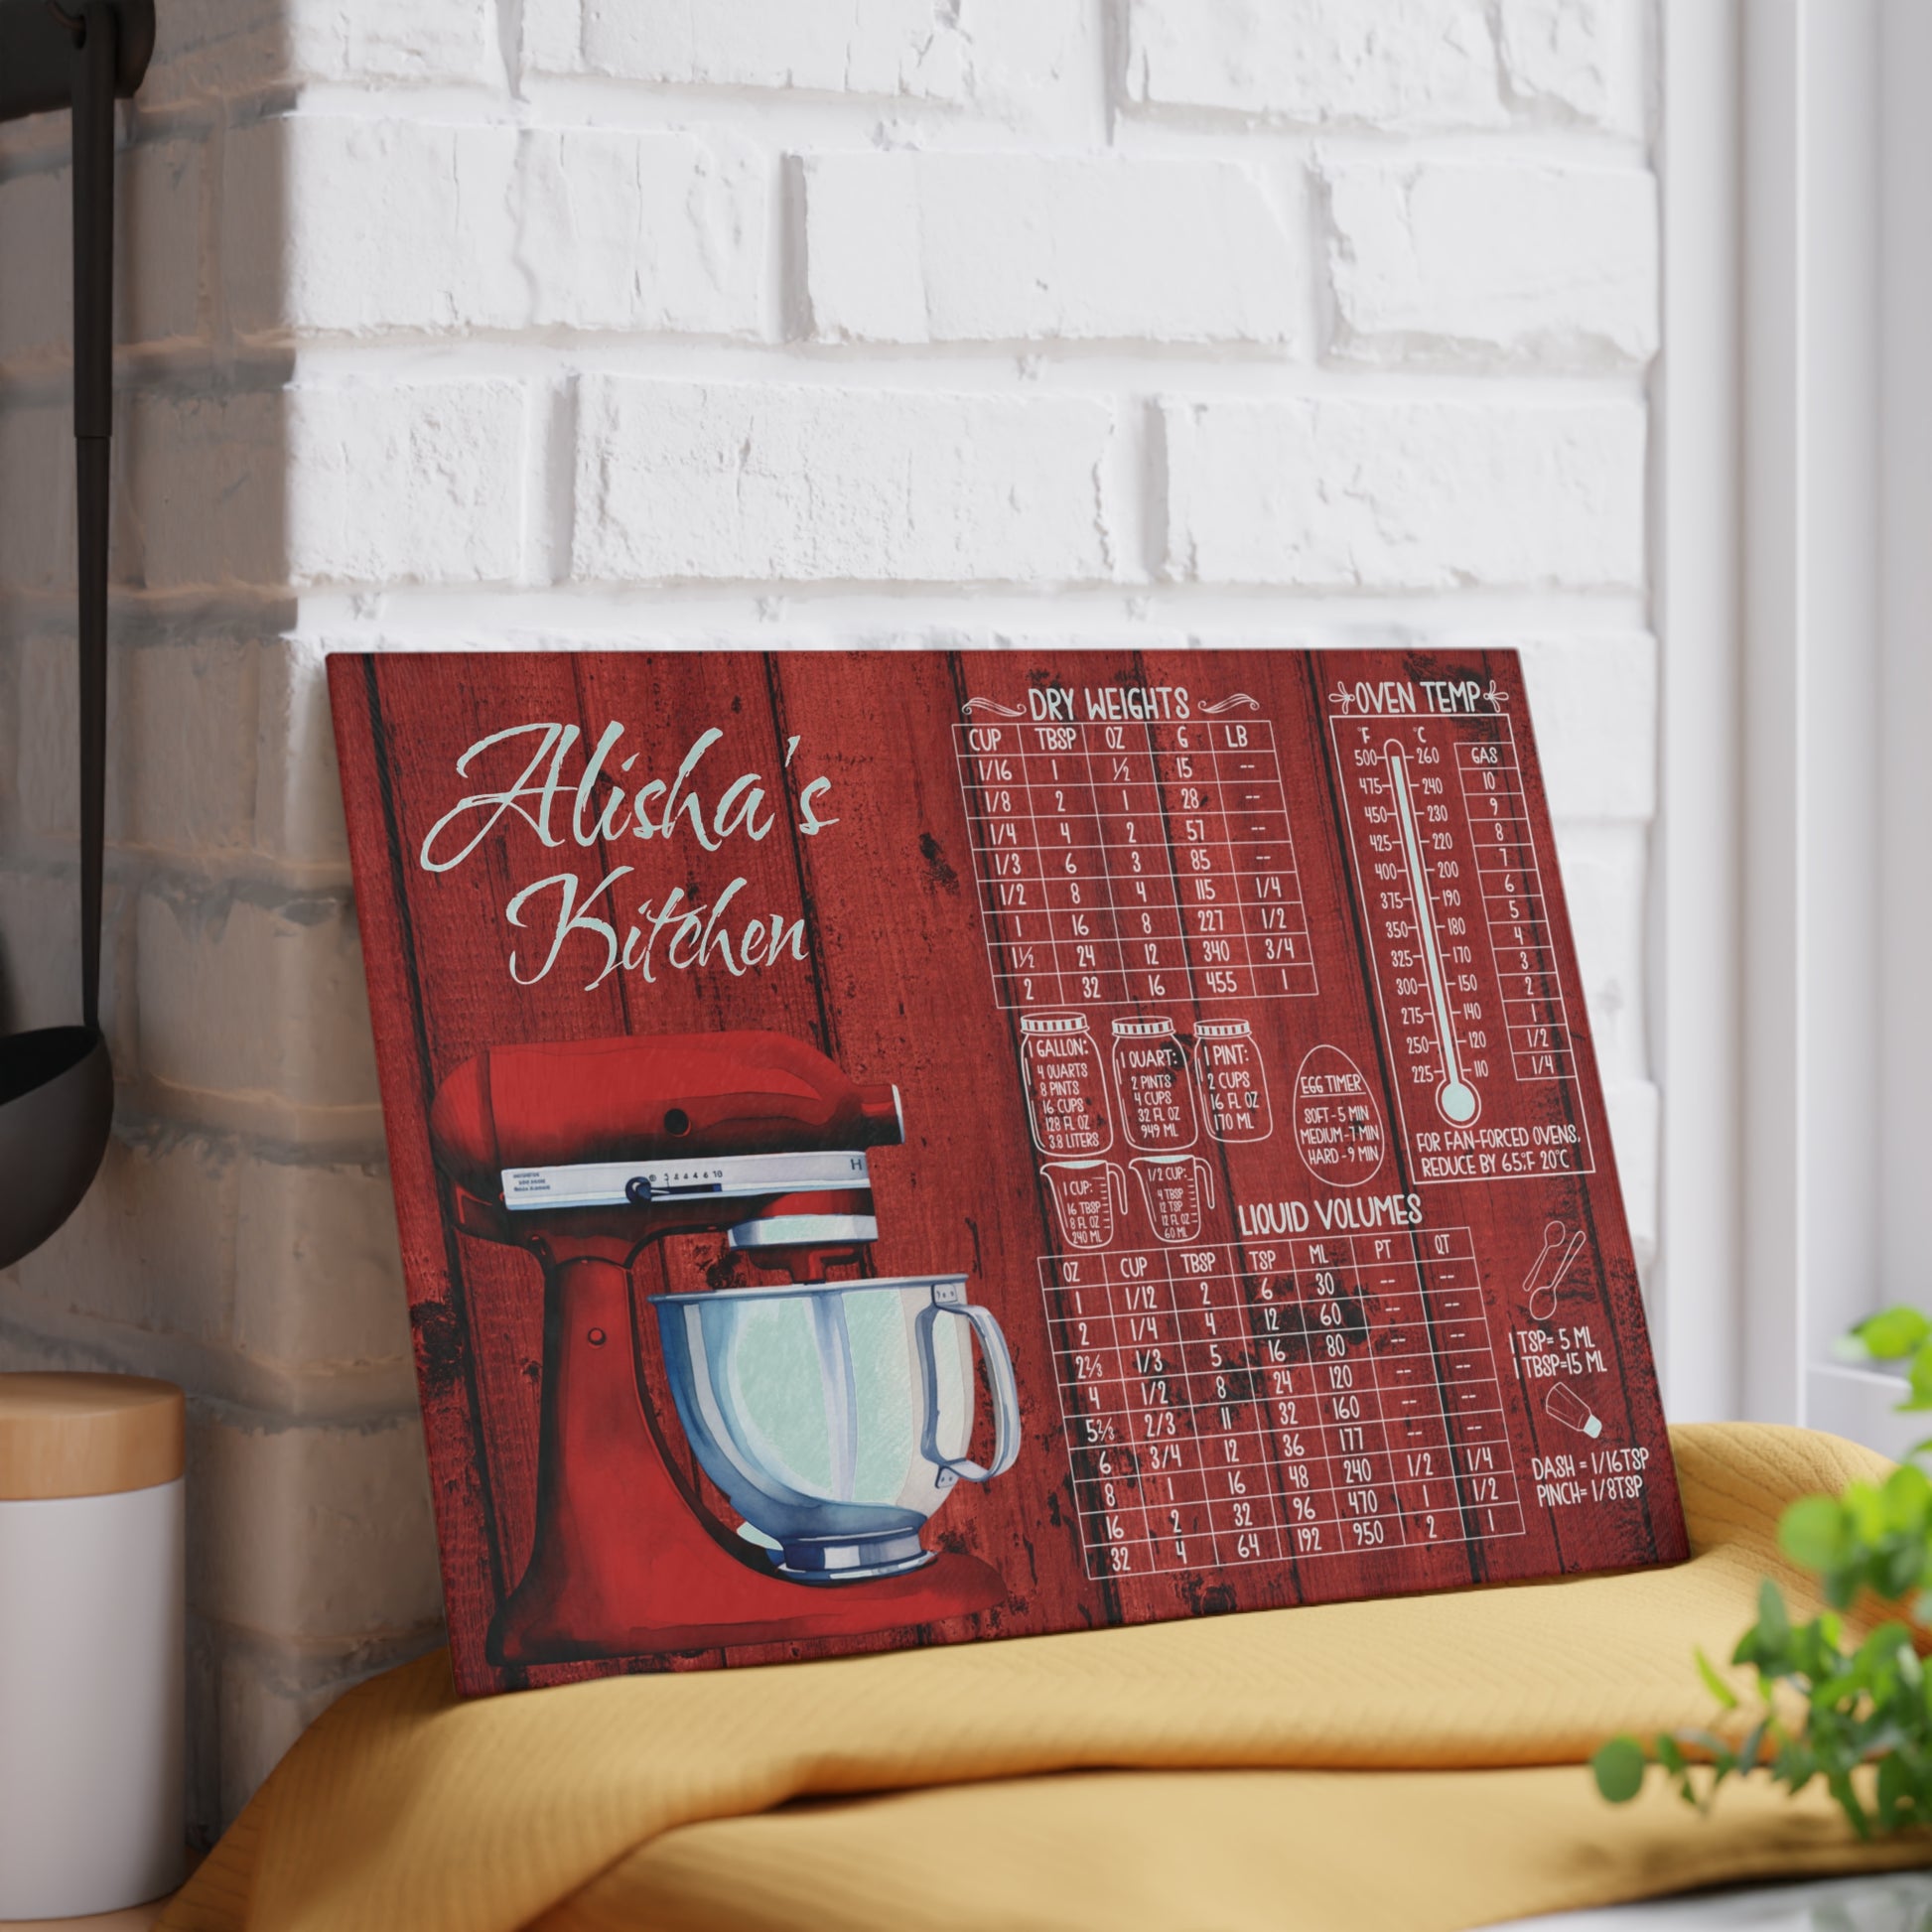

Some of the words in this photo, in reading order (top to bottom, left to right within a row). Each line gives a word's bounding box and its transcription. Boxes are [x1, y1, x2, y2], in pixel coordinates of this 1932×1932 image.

[1028, 688, 1074, 721] DRY
[1084, 687, 1190, 720] WEIGHTS
[1355, 681, 1416, 714] OVEN
[1420, 681, 1480, 713] TEMP
[969, 728, 1002, 752] CUP
[1035, 728, 1076, 751] TBSP
[1105, 726, 1125, 750] OZ
[1225, 725, 1248, 748] LB
[1354, 749, 1377, 766] 500
[1416, 747, 1440, 764] 260
[1471, 747, 1498, 763] GAS
[979, 759, 1013, 781] 1/16
[1176, 758, 1192, 778] 15
[1482, 771, 1495, 790] 10
[420, 720, 840, 873] Alisha's
[985, 790, 1011, 812] 1/8
[1180, 787, 1199, 809] 28
[1364, 806, 1387, 823] 450
[1427, 804, 1448, 822] 230
[990, 823, 1017, 845] 1/4
[1185, 819, 1204, 841] 57
[995, 853, 1022, 875] 1/3
[1190, 849, 1211, 871] 85
[1375, 863, 1398, 880] 400
[1438, 861, 1458, 879] 200
[1000, 884, 1027, 905] 1/2
[1195, 879, 1215, 900] 115
[1256, 877, 1282, 898] 1/4
[505, 866, 808, 991] Kitchen
[1072, 914, 1089, 936] 16
[1197, 909, 1223, 931] 227
[1262, 907, 1287, 929] 1/2
[1386, 920, 1409, 938] 350
[1448, 917, 1465, 935] 180
[1076, 945, 1095, 967] 24
[1145, 943, 1159, 965] 12
[1202, 939, 1230, 962] 340
[1265, 938, 1295, 959] 3/4
[1082, 976, 1101, 998] 32
[1148, 974, 1166, 996] 16
[1206, 971, 1237, 993] 455
[1396, 978, 1419, 996] 300
[1457, 974, 1477, 992] 150
[1407, 1035, 1430, 1054] 250
[1468, 1031, 1486, 1048] 120
[1527, 1028, 1549, 1047] 1/2
[1036, 1038, 1088, 1057] GALLON:
[1212, 1043, 1249, 1065] PINT:
[1473, 1059, 1488, 1077] 110
[1532, 1054, 1554, 1074] 1/4
[1140, 1074, 1172, 1089] PINTS
[1218, 1071, 1250, 1089] CUPS
[1301, 1075, 1323, 1094] EGG
[1324, 1073, 1361, 1092] TIMER
[1412, 1065, 1435, 1083] 225
[1049, 1080, 1079, 1096] PINTS
[1042, 1099, 1054, 1114] 16
[1057, 1097, 1084, 1113] CUPS
[1144, 1090, 1172, 1106] CUPS
[1210, 1093, 1224, 1110] 16
[1227, 1092, 1242, 1109] FL
[1244, 1091, 1260, 1108] OZ
[1045, 1116, 1061, 1132] 128
[1077, 1115, 1090, 1130] OZ
[1138, 1108, 1151, 1122] 32
[1153, 1107, 1166, 1122] FL
[1168, 1106, 1180, 1121] OZ
[1214, 1113, 1233, 1131] 170
[1236, 1112, 1254, 1129] ML
[1304, 1107, 1329, 1124] SOFT
[1348, 1105, 1369, 1121] MIN
[1141, 1124, 1160, 1139] 949
[1163, 1123, 1178, 1137] ML
[1300, 1127, 1343, 1145] MEDIUM
[1358, 1125, 1380, 1141] MIN
[1416, 1132, 1442, 1153] FOR
[1444, 1127, 1529, 1151] FAN-FORCED
[1533, 1124, 1581, 1146] OVENS,
[1048, 1134, 1063, 1150] 3.8
[1065, 1132, 1099, 1149] LITERS
[1308, 1148, 1339, 1165] HARD
[1357, 1146, 1379, 1162] MIN
[1148, 1168, 1164, 1181] 1/2
[1166, 1166, 1187, 1180] CUP:
[1421, 1155, 1476, 1177] REDUCE
[1478, 1154, 1495, 1173] BY
[1069, 1180, 1093, 1195] CUP:
[1164, 1187, 1183, 1200] TBSP
[1067, 1202, 1077, 1215] 16
[1078, 1200, 1101, 1214] TBSP
[1168, 1200, 1183, 1212] TSP
[1238, 1201, 1309, 1236] LIQUID
[1313, 1193, 1423, 1230] VOLUMES
[1071, 1231, 1088, 1244] 240
[1089, 1230, 1102, 1242] ML
[1165, 1227, 1175, 1239] 60
[1176, 1227, 1187, 1237] ML
[1063, 1261, 1080, 1283] OZ
[1120, 1256, 1148, 1278] CUP
[1180, 1252, 1215, 1274] TBSP
[1248, 1250, 1276, 1271] TSP
[1309, 1244, 1329, 1264] ML
[1374, 1239, 1391, 1260] PT
[1435, 1234, 1449, 1255] QT
[1125, 1286, 1158, 1311] 1/12
[1315, 1272, 1334, 1296] 30
[1130, 1316, 1158, 1341] 1/4
[1264, 1308, 1279, 1330] 12
[1320, 1303, 1341, 1325] 60
[1574, 1326, 1595, 1348] ML
[1136, 1348, 1163, 1373] 1/3
[1268, 1339, 1286, 1362] 16
[1325, 1333, 1345, 1357] 80
[1586, 1350, 1607, 1373] ML
[1141, 1380, 1169, 1406] 1/2
[1273, 1370, 1293, 1394] 24
[1328, 1364, 1352, 1389] 120
[1145, 1412, 1175, 1438] 2/3
[1279, 1401, 1299, 1425] 32
[1332, 1395, 1360, 1420] 160
[1150, 1444, 1181, 1469] 3/4
[1224, 1439, 1239, 1462] 12
[1283, 1434, 1305, 1457] 36
[1339, 1427, 1363, 1451] 177
[1228, 1470, 1246, 1495] 16
[1289, 1464, 1309, 1488] 48
[1343, 1458, 1371, 1483] 240
[1407, 1452, 1434, 1477] 1/2
[1466, 1447, 1493, 1471] 1/4
[1531, 1454, 1576, 1480] DASH
[1106, 1515, 1124, 1540] 16
[1233, 1502, 1253, 1527] 32
[1293, 1496, 1315, 1521] 96
[1348, 1489, 1377, 1514] 470
[1472, 1477, 1499, 1501] 1/2
[1111, 1547, 1131, 1572] 32
[1238, 1533, 1260, 1558] 64
[1298, 1527, 1321, 1552] 192
[1353, 1520, 1384, 1546] 950
